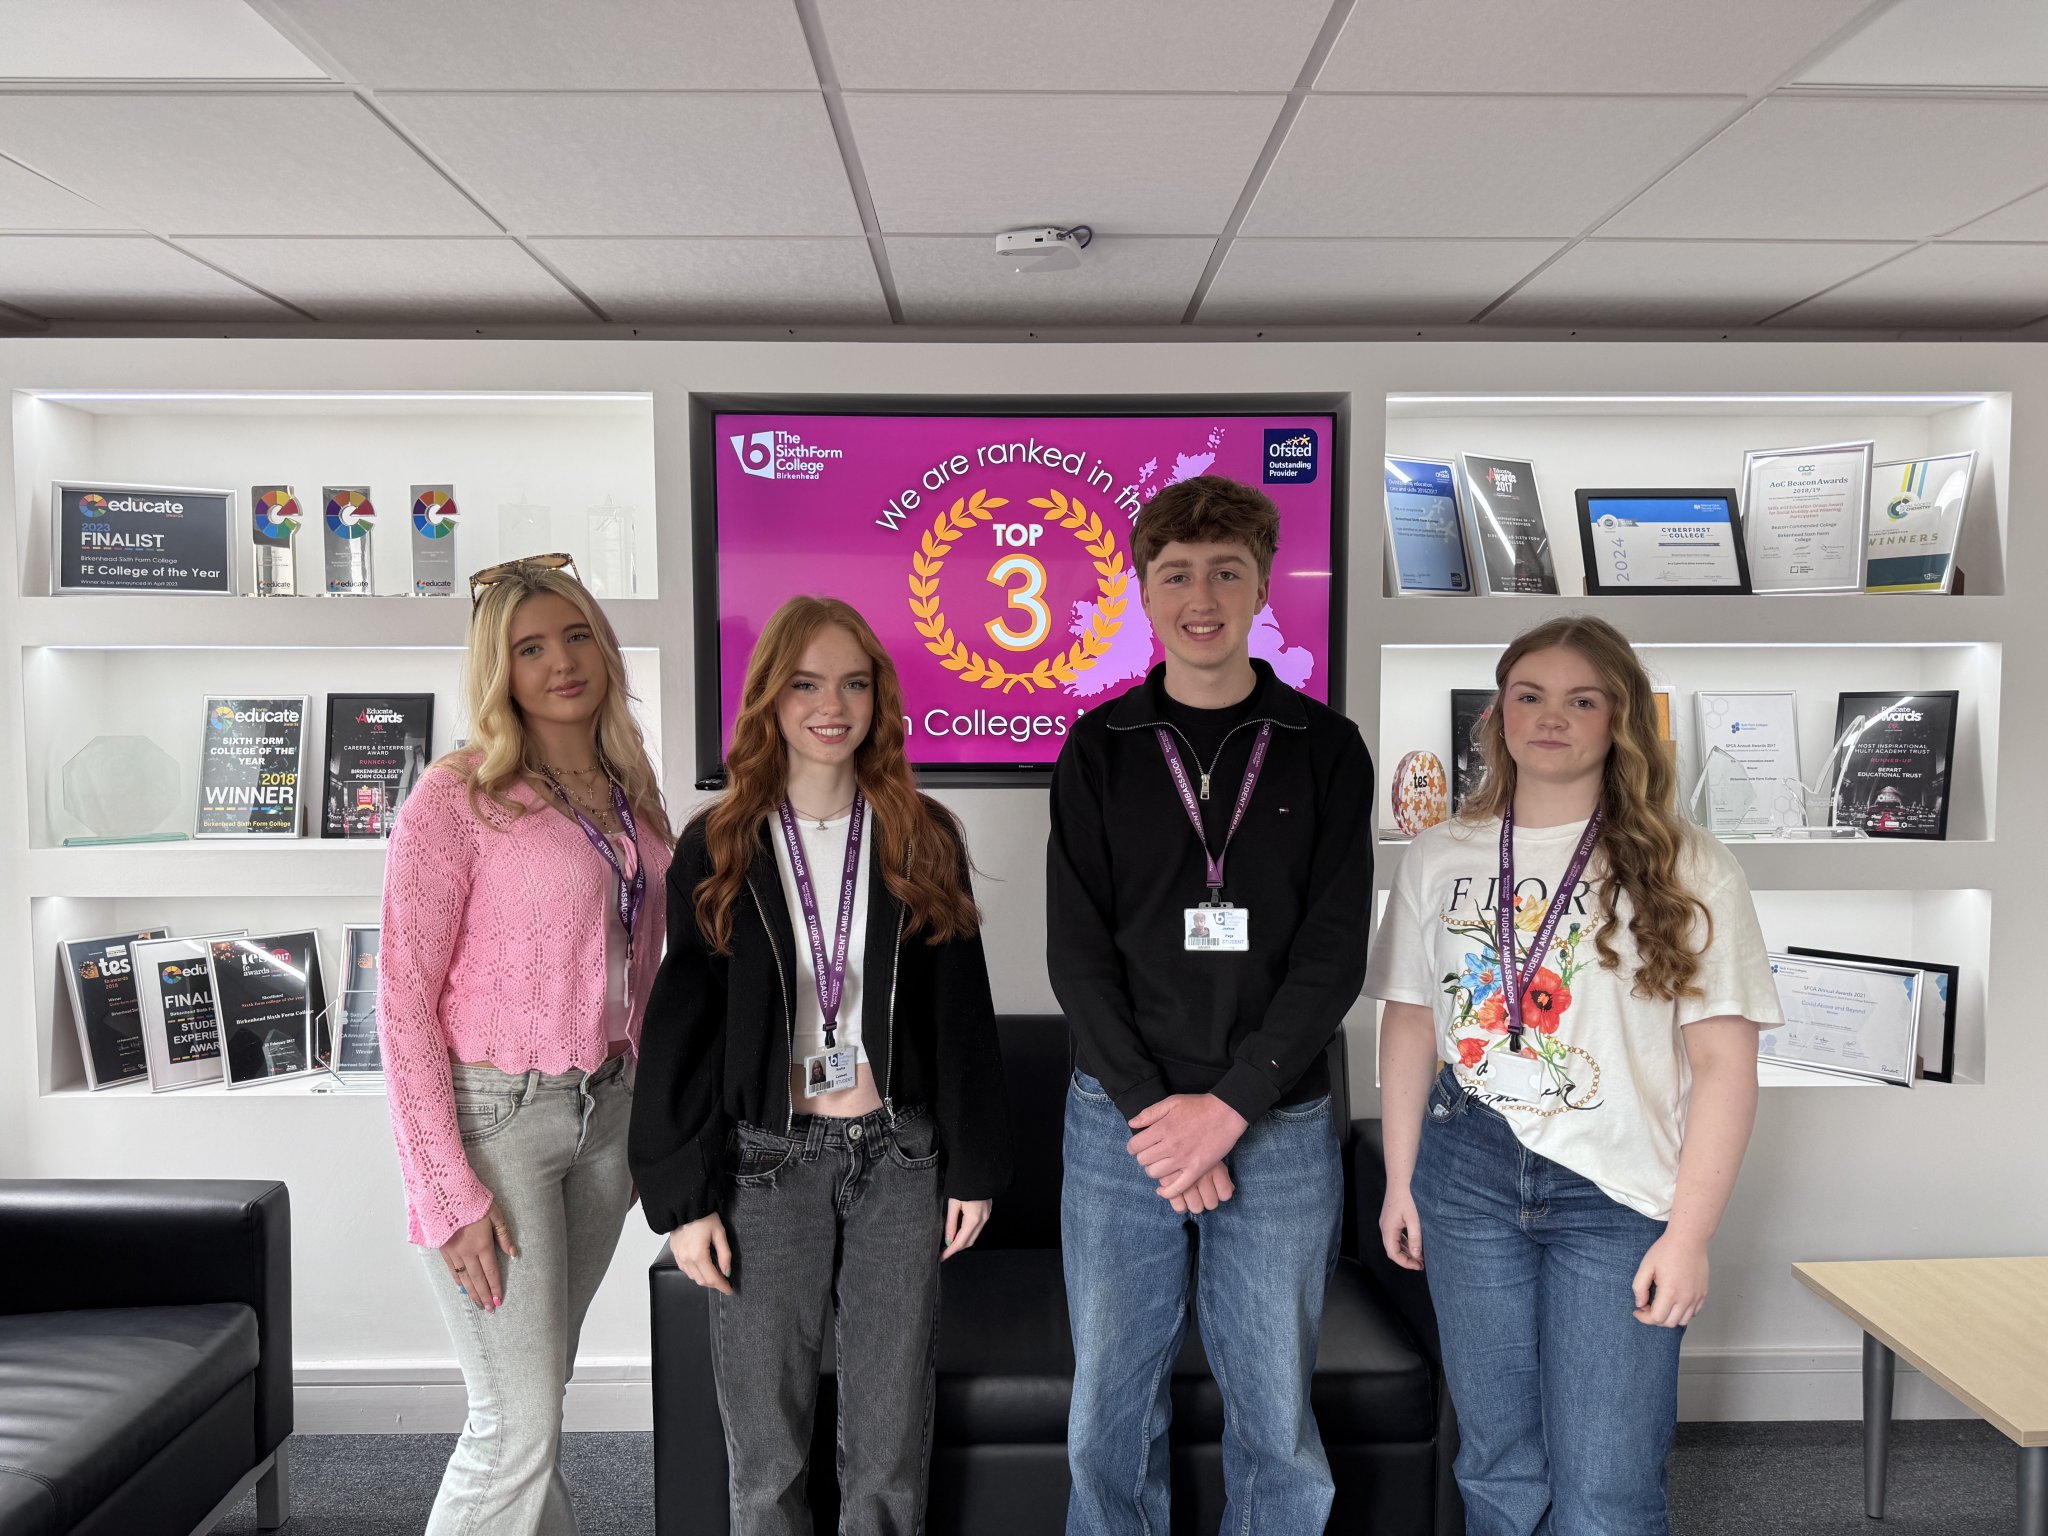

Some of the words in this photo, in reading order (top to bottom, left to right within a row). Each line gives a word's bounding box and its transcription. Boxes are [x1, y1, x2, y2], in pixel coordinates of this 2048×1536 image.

[775, 431, 800, 444] The
[776, 444, 842, 458] SixthForm
[1269, 443, 1311, 457] Ofsted
[776, 459, 824, 474] College
[1269, 461, 1311, 470] Outstanding
[776, 472, 819, 480] Birkenhead
[875, 489, 921, 532] We
[922, 455, 970, 491] are
[976, 437, 1086, 476] ranked
[1086, 459, 1114, 494] in
[1496, 482, 1512, 493] 2017
[108, 497, 184, 514] educate
[81, 522, 111, 531] 2023
[81, 532, 165, 548] FINALIST
[992, 523, 1044, 547] TOP
[1868, 533, 1938, 546] WINNERS
[1611, 537, 1630, 582] 2024
[81, 565, 95, 575] FE
[98, 565, 148, 578] College
[152, 567, 165, 576] of
[168, 568, 188, 577] the
[191, 568, 221, 578] Year
[340, 580, 369, 588] educate
[984, 553, 1052, 652] 3
[235, 708, 299, 722] educate
[355, 709, 403, 724] Awards
[924, 709, 1067, 743] Colleges
[222, 737, 253, 745] SIXTH
[255, 737, 284, 745] FORM
[210, 747, 256, 755] COLLEGE
[259, 747, 272, 755] OF
[275, 747, 295, 755] THE
[239, 757, 265, 765] YEAR
[261, 773, 295, 785] 2018
[1170, 757, 1196, 810] AMBASSADOR
[1413, 772, 1428, 788] tes
[205, 786, 294, 804] WINNER
[1239, 772, 1255, 808] STUDENT
[851, 809, 863, 842] STUDENT
[1502, 819, 1511, 869] AMBASSADOR
[1579, 822, 1600, 856] STUDENT
[785, 825, 805, 877] AMBASSADOR
[808, 914, 822, 951] STUDENT
[835, 933, 847, 972] STUDENT
[841, 879, 853, 933] AMBASSADOR
[1501, 907, 1510, 944] STUDENT
[1522, 946, 1544, 983] STUDENT
[1538, 893, 1568, 948] AMBASSADOR
[98, 958, 131, 977] tes
[243, 967, 270, 977] awards
[1502, 945, 1516, 1004] AMBASSADOR
[165, 991, 214, 1008] FINAL
[1835, 989, 1853, 997] Awards
[1801, 1000, 1816, 1008] Covid
[181, 1020, 217, 1031] STUDE
[236, 1016, 266, 1025] Birkenhead
[173, 1031, 219, 1044] EXPERIE
[189, 1041, 220, 1053] AWAR
